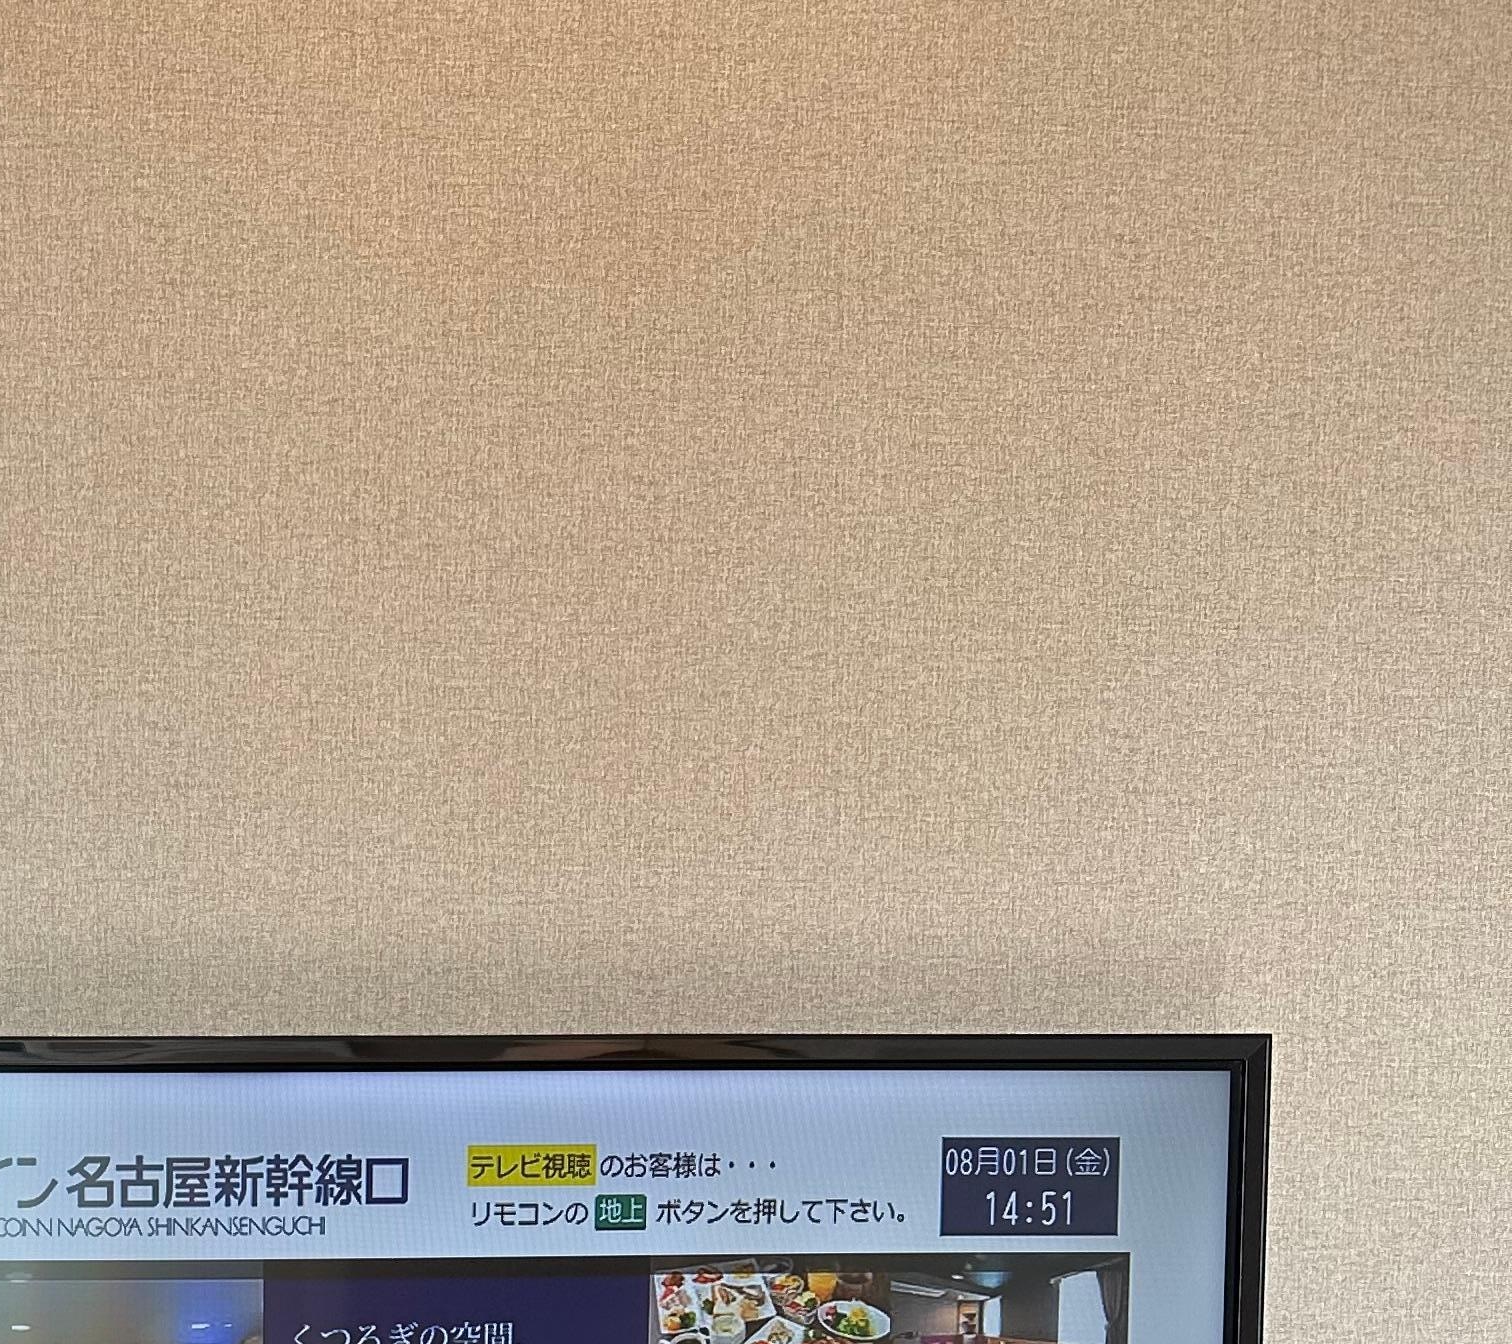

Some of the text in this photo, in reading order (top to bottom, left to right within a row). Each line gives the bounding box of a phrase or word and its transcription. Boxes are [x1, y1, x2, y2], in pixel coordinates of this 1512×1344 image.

[469, 1152, 593, 1180] テレビ視聴
[470, 1197, 908, 1227] リモコンの 地上 ボタンを押して下さい。
[985, 1191, 1074, 1226] 14:51
[57, 1217, 143, 1238] NAGOYA
[147, 1215, 326, 1238] SHINKANSENGUCHI
